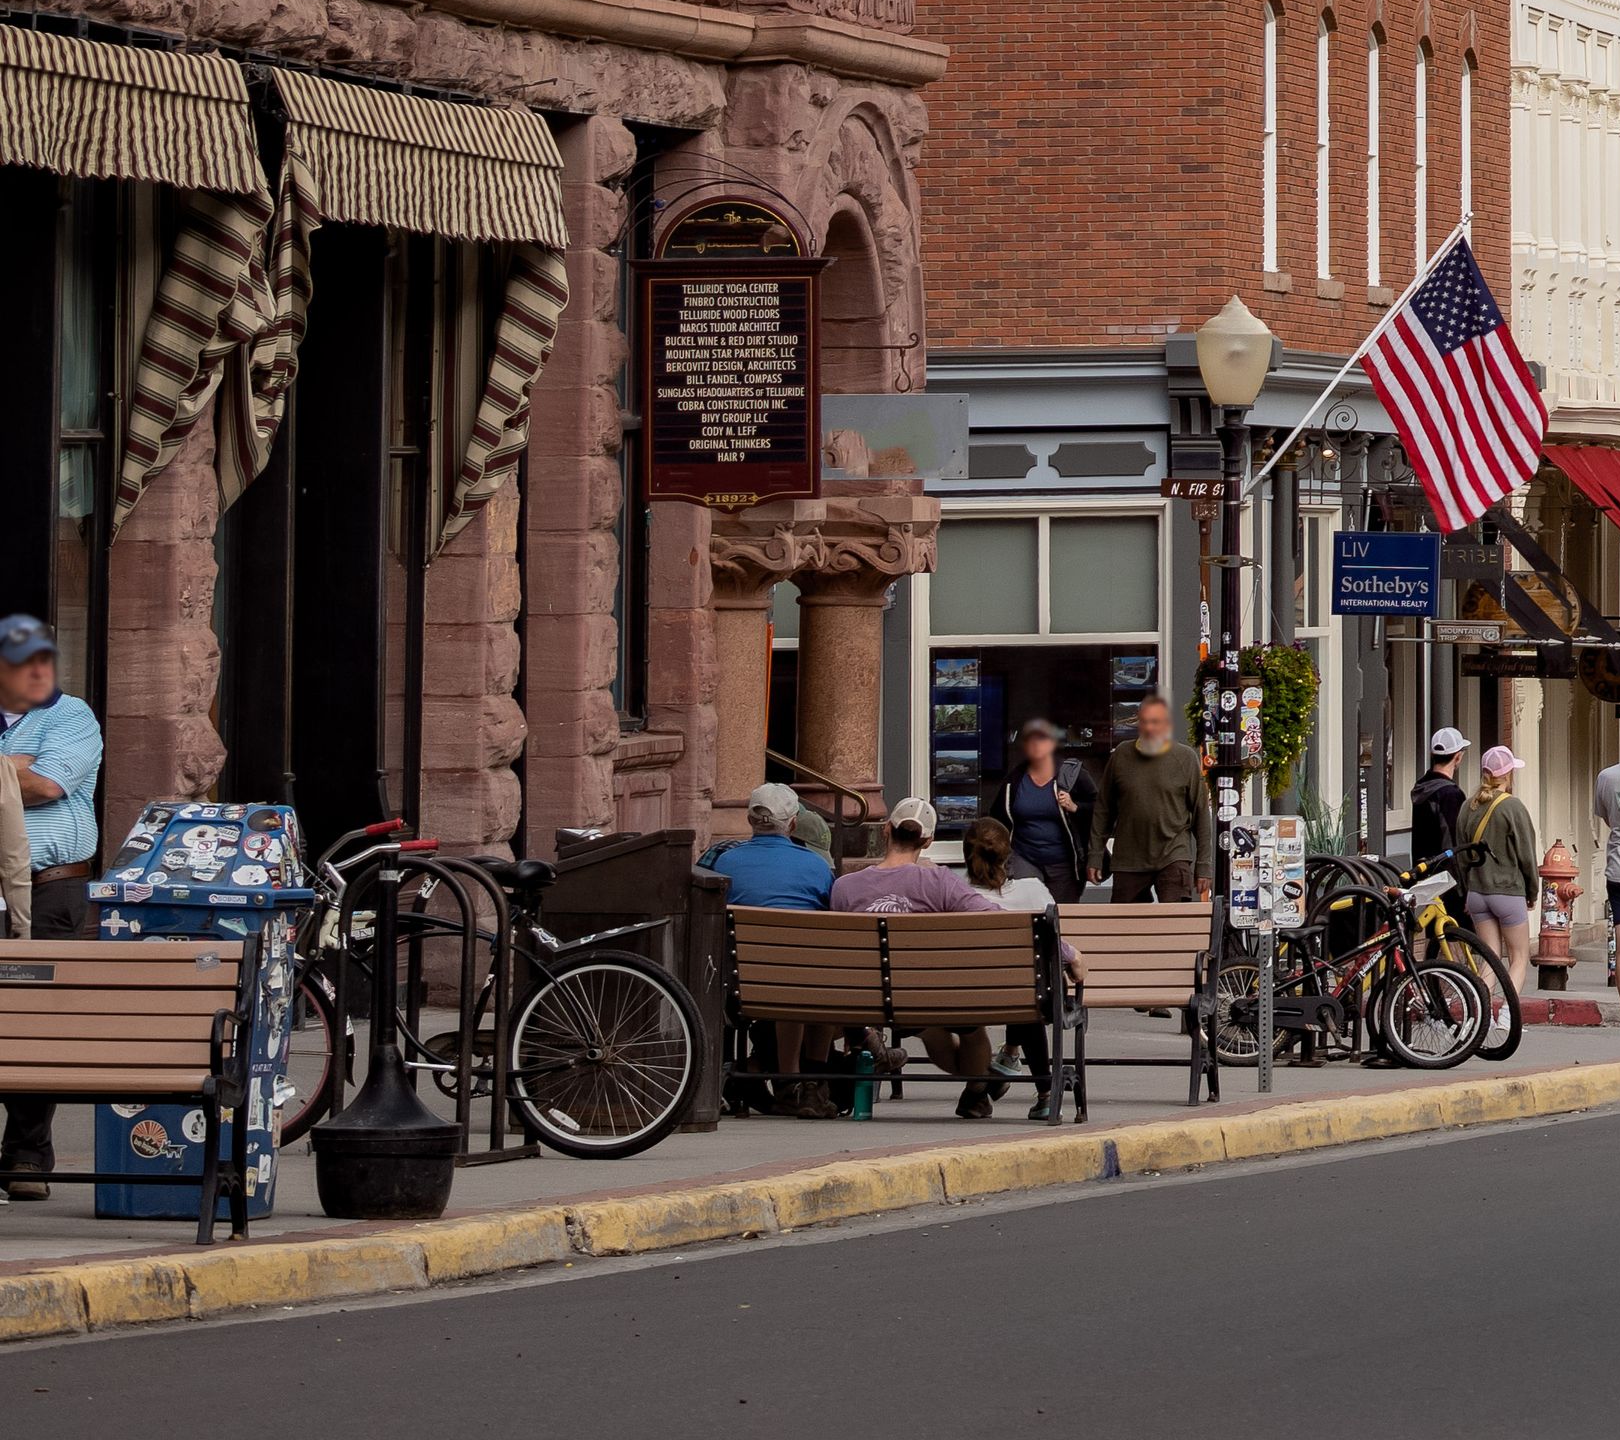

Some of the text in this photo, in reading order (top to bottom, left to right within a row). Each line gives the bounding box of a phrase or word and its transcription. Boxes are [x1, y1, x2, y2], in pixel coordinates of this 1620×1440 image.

[682, 283, 779, 294] TELLURIDE YOGA CENTER
[684, 296, 780, 307] FINBRO CONSTRUCTION
[679, 309, 780, 320] TELLURIDE WOOD FLOORS
[680, 321, 781, 333] NARCIS TUDOR ARCHITECT
[665, 335, 798, 346] BUCKEL WINE & RED DIRT STUDIO
[665, 347, 795, 359] MOUNTAIN STAR PARTNERS, LLC
[666, 360, 797, 372] BERCOVITZ DESIGN, ARCHITECTS
[686, 374, 783, 386] BILL FANDEL, COMPASS
[657, 388, 695, 398] SUNGLASS
[697, 387, 754, 398] HEADQUARTERS
[765, 387, 805, 397] TELLURIDE
[677, 399, 788, 411] COBRA CONSTRUCTION INC.
[701, 413, 721, 423] BIVY
[753, 413, 769, 423] LLC
[702, 426, 757, 437] CODY M. LEFF
[689, 439, 771, 450] ORIGINAL THINKERS
[717, 452, 745, 462] HAIR 9
[1171, 482, 1184, 496] N.
[1188, 483, 1208, 496] FIR
[715, 495, 748, 503] 1892
[1342, 542, 1370, 558] LIV
[1340, 576, 1429, 598] Sotheby's
[1340, 599, 1429, 608] INTERNATIONAL REALTY
[1440, 627, 1482, 636] MOUNTAIN
